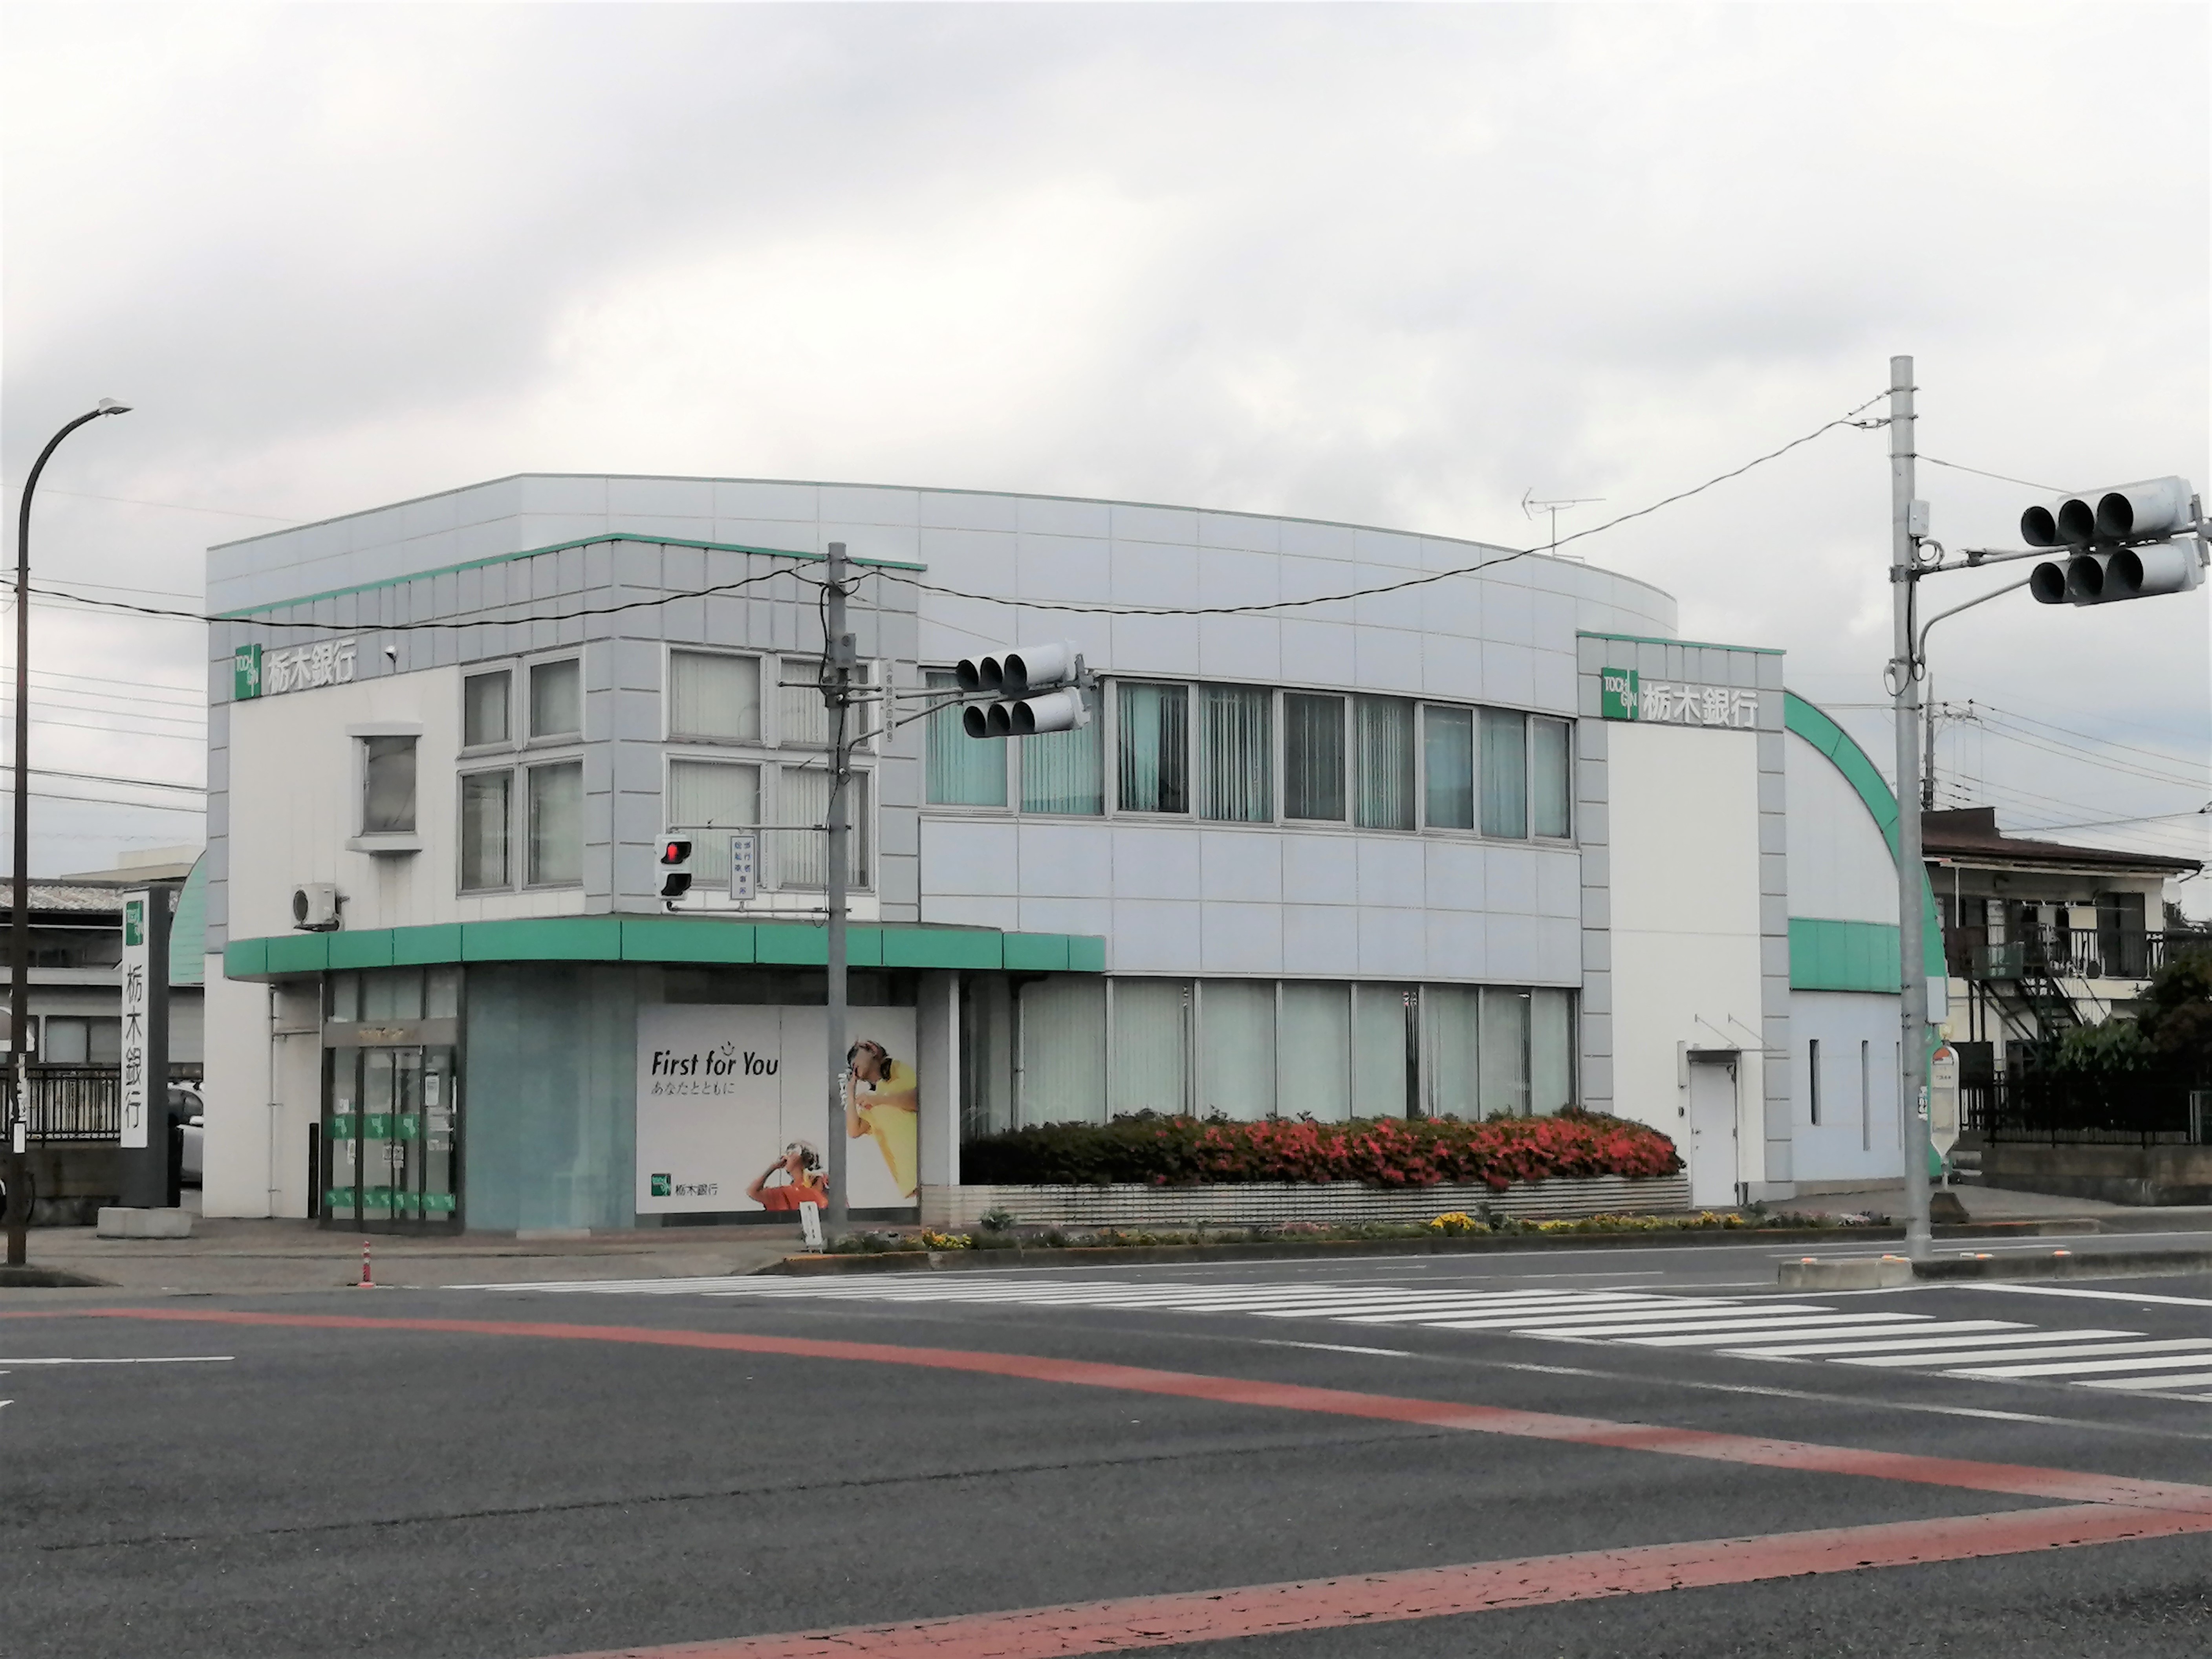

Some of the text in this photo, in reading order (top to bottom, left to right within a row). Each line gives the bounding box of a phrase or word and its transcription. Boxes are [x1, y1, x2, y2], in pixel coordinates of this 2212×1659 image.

[268, 639, 357, 694] 栃木銀行
[1643, 683, 1759, 727] 栃木銀行
[125, 963, 143, 1128] 栃木銀行
[652, 1050, 778, 1076] First for You
[651, 1081, 735, 1096] あなたとともに
